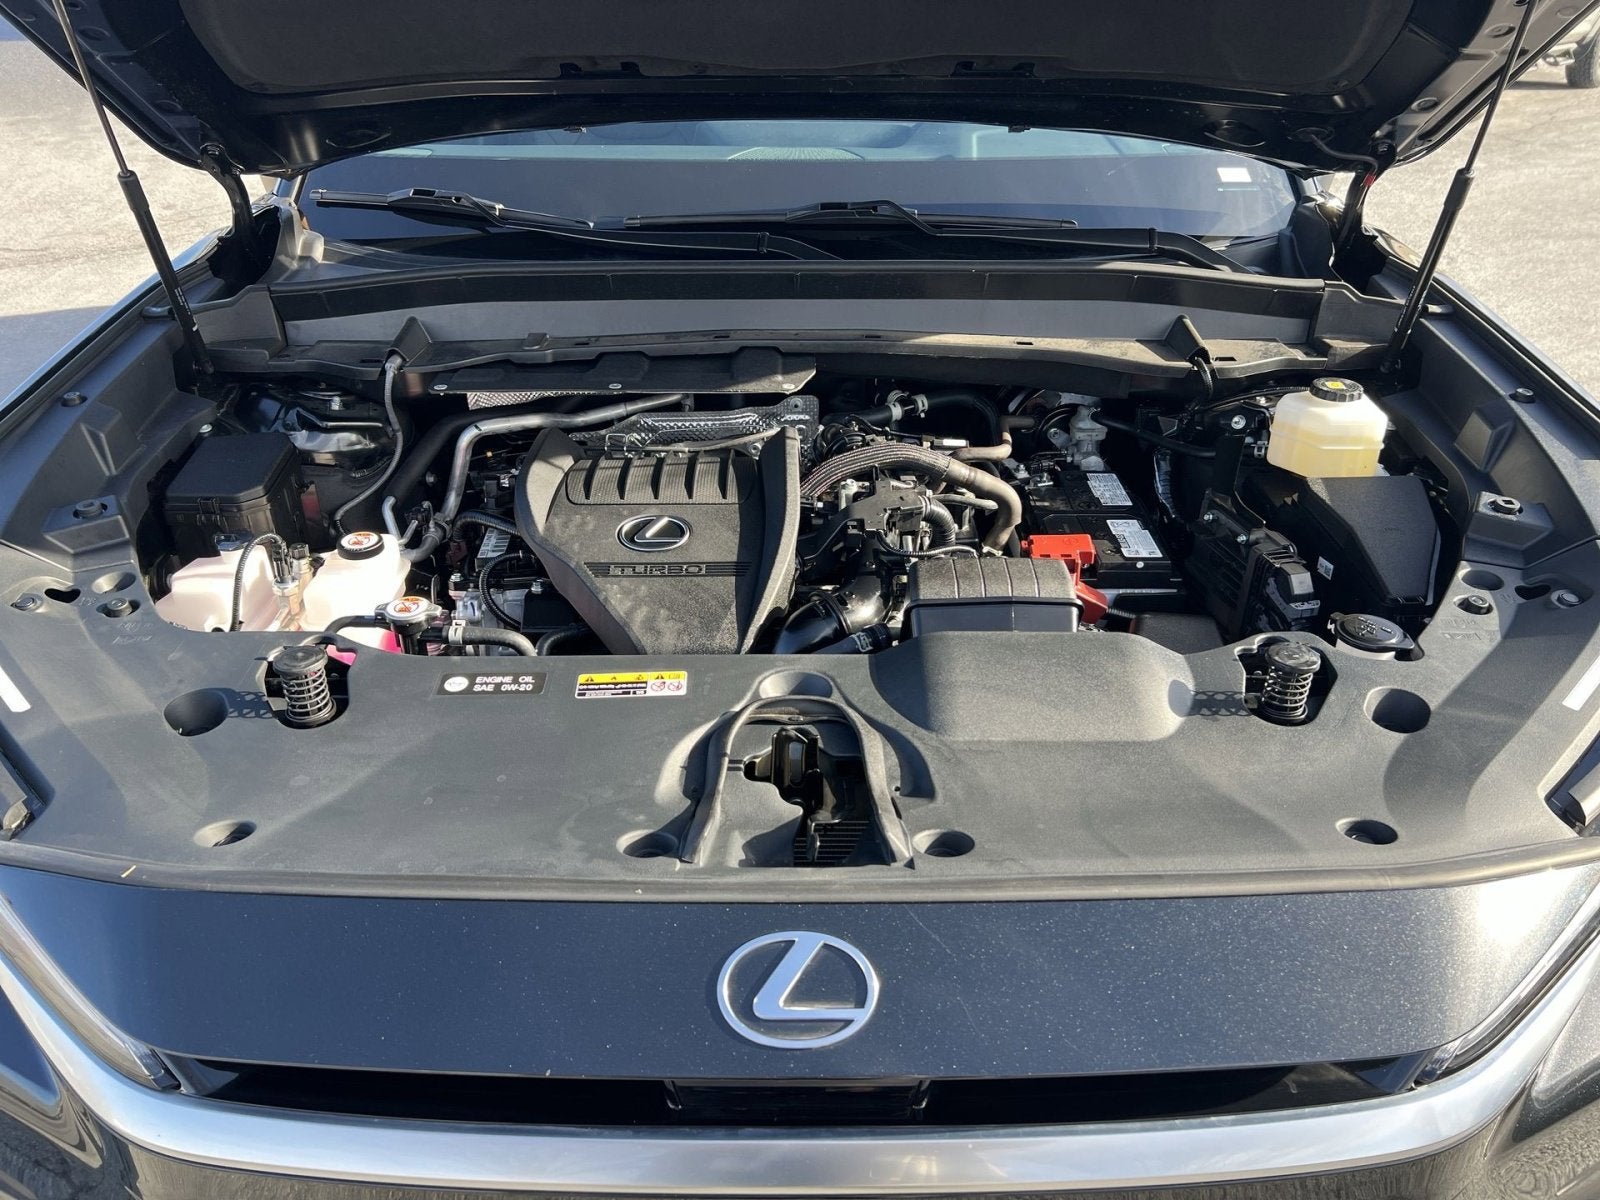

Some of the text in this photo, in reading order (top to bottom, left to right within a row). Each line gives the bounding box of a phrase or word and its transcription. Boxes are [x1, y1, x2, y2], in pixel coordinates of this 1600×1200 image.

[613, 564, 702, 575] TURBO
[475, 675, 514, 684] ENGINE
[518, 675, 536, 684] OIL
[472, 683, 496, 692] SAE
[500, 683, 534, 692] 0W-20
